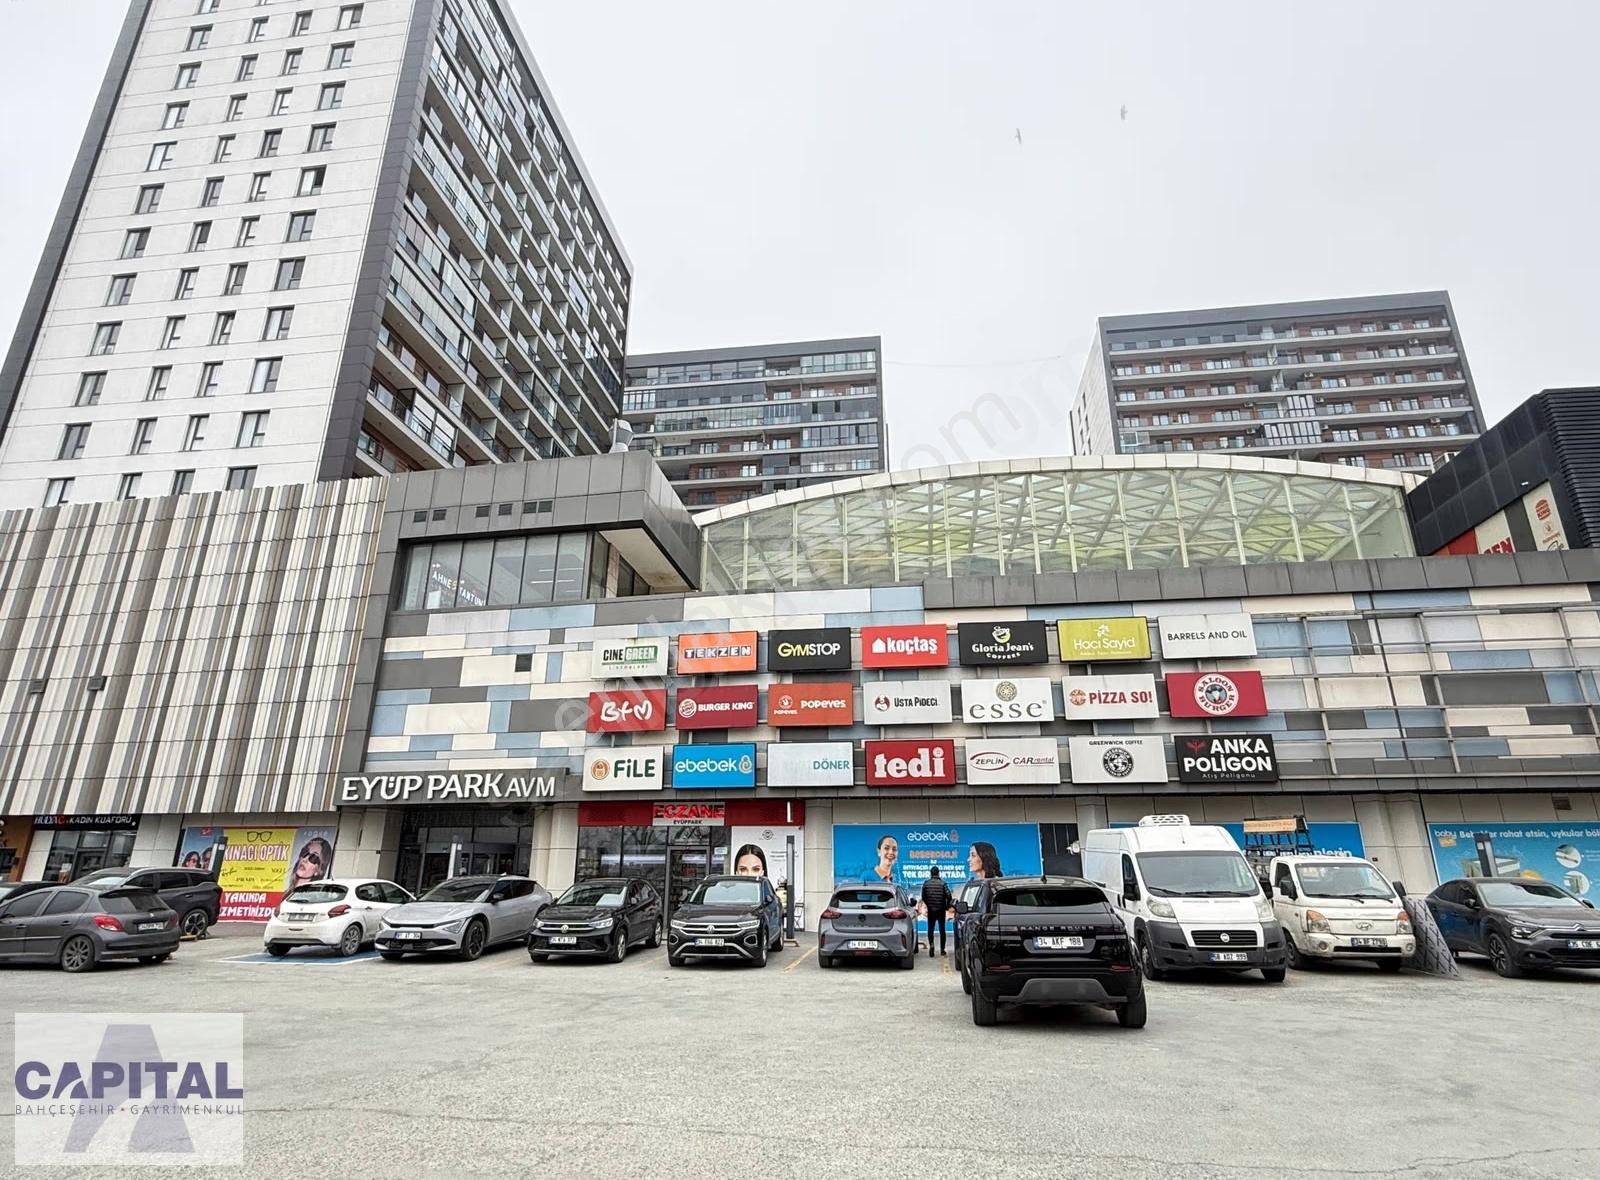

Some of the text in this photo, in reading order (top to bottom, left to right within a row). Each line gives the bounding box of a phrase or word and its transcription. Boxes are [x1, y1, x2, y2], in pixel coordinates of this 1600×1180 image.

[1167, 630, 1248, 641] BARRELS AND OIL
[685, 646, 752, 659] TEKZEN
[777, 642, 841, 657] GYMSTOP
[887, 636, 938, 655] koçtaş
[972, 641, 1034, 653] Gloria Jean's
[603, 647, 655, 662] CINE GREEN
[1198, 677, 1234, 693] SALOON
[894, 697, 914, 707] USTA
[1089, 690, 1153, 704] PİZZA SO!
[1198, 694, 1235, 712] BURGER
[698, 702, 731, 712] BURGER
[732, 701, 754, 711] KING
[969, 702, 1042, 719] esse
[1210, 738, 1269, 754] ANKA
[675, 757, 738, 774] ebebek
[813, 758, 850, 770] DÖNER
[874, 746, 946, 778] tedi
[975, 757, 1004, 765] ZEPLİN
[1013, 757, 1034, 765] CAR
[1183, 754, 1273, 772] POLİGON
[341, 773, 556, 801] EYÜP PARK AVM
[654, 803, 725, 819] ECZANE
[69, 815, 93, 824] KADIN
[907, 831, 949, 842] ebebek
[1499, 829, 1523, 838] rahat
[259, 841, 289, 861] OPTİK
[224, 892, 267, 903] YAKINDA
[1038, 937, 1048, 946] 34
